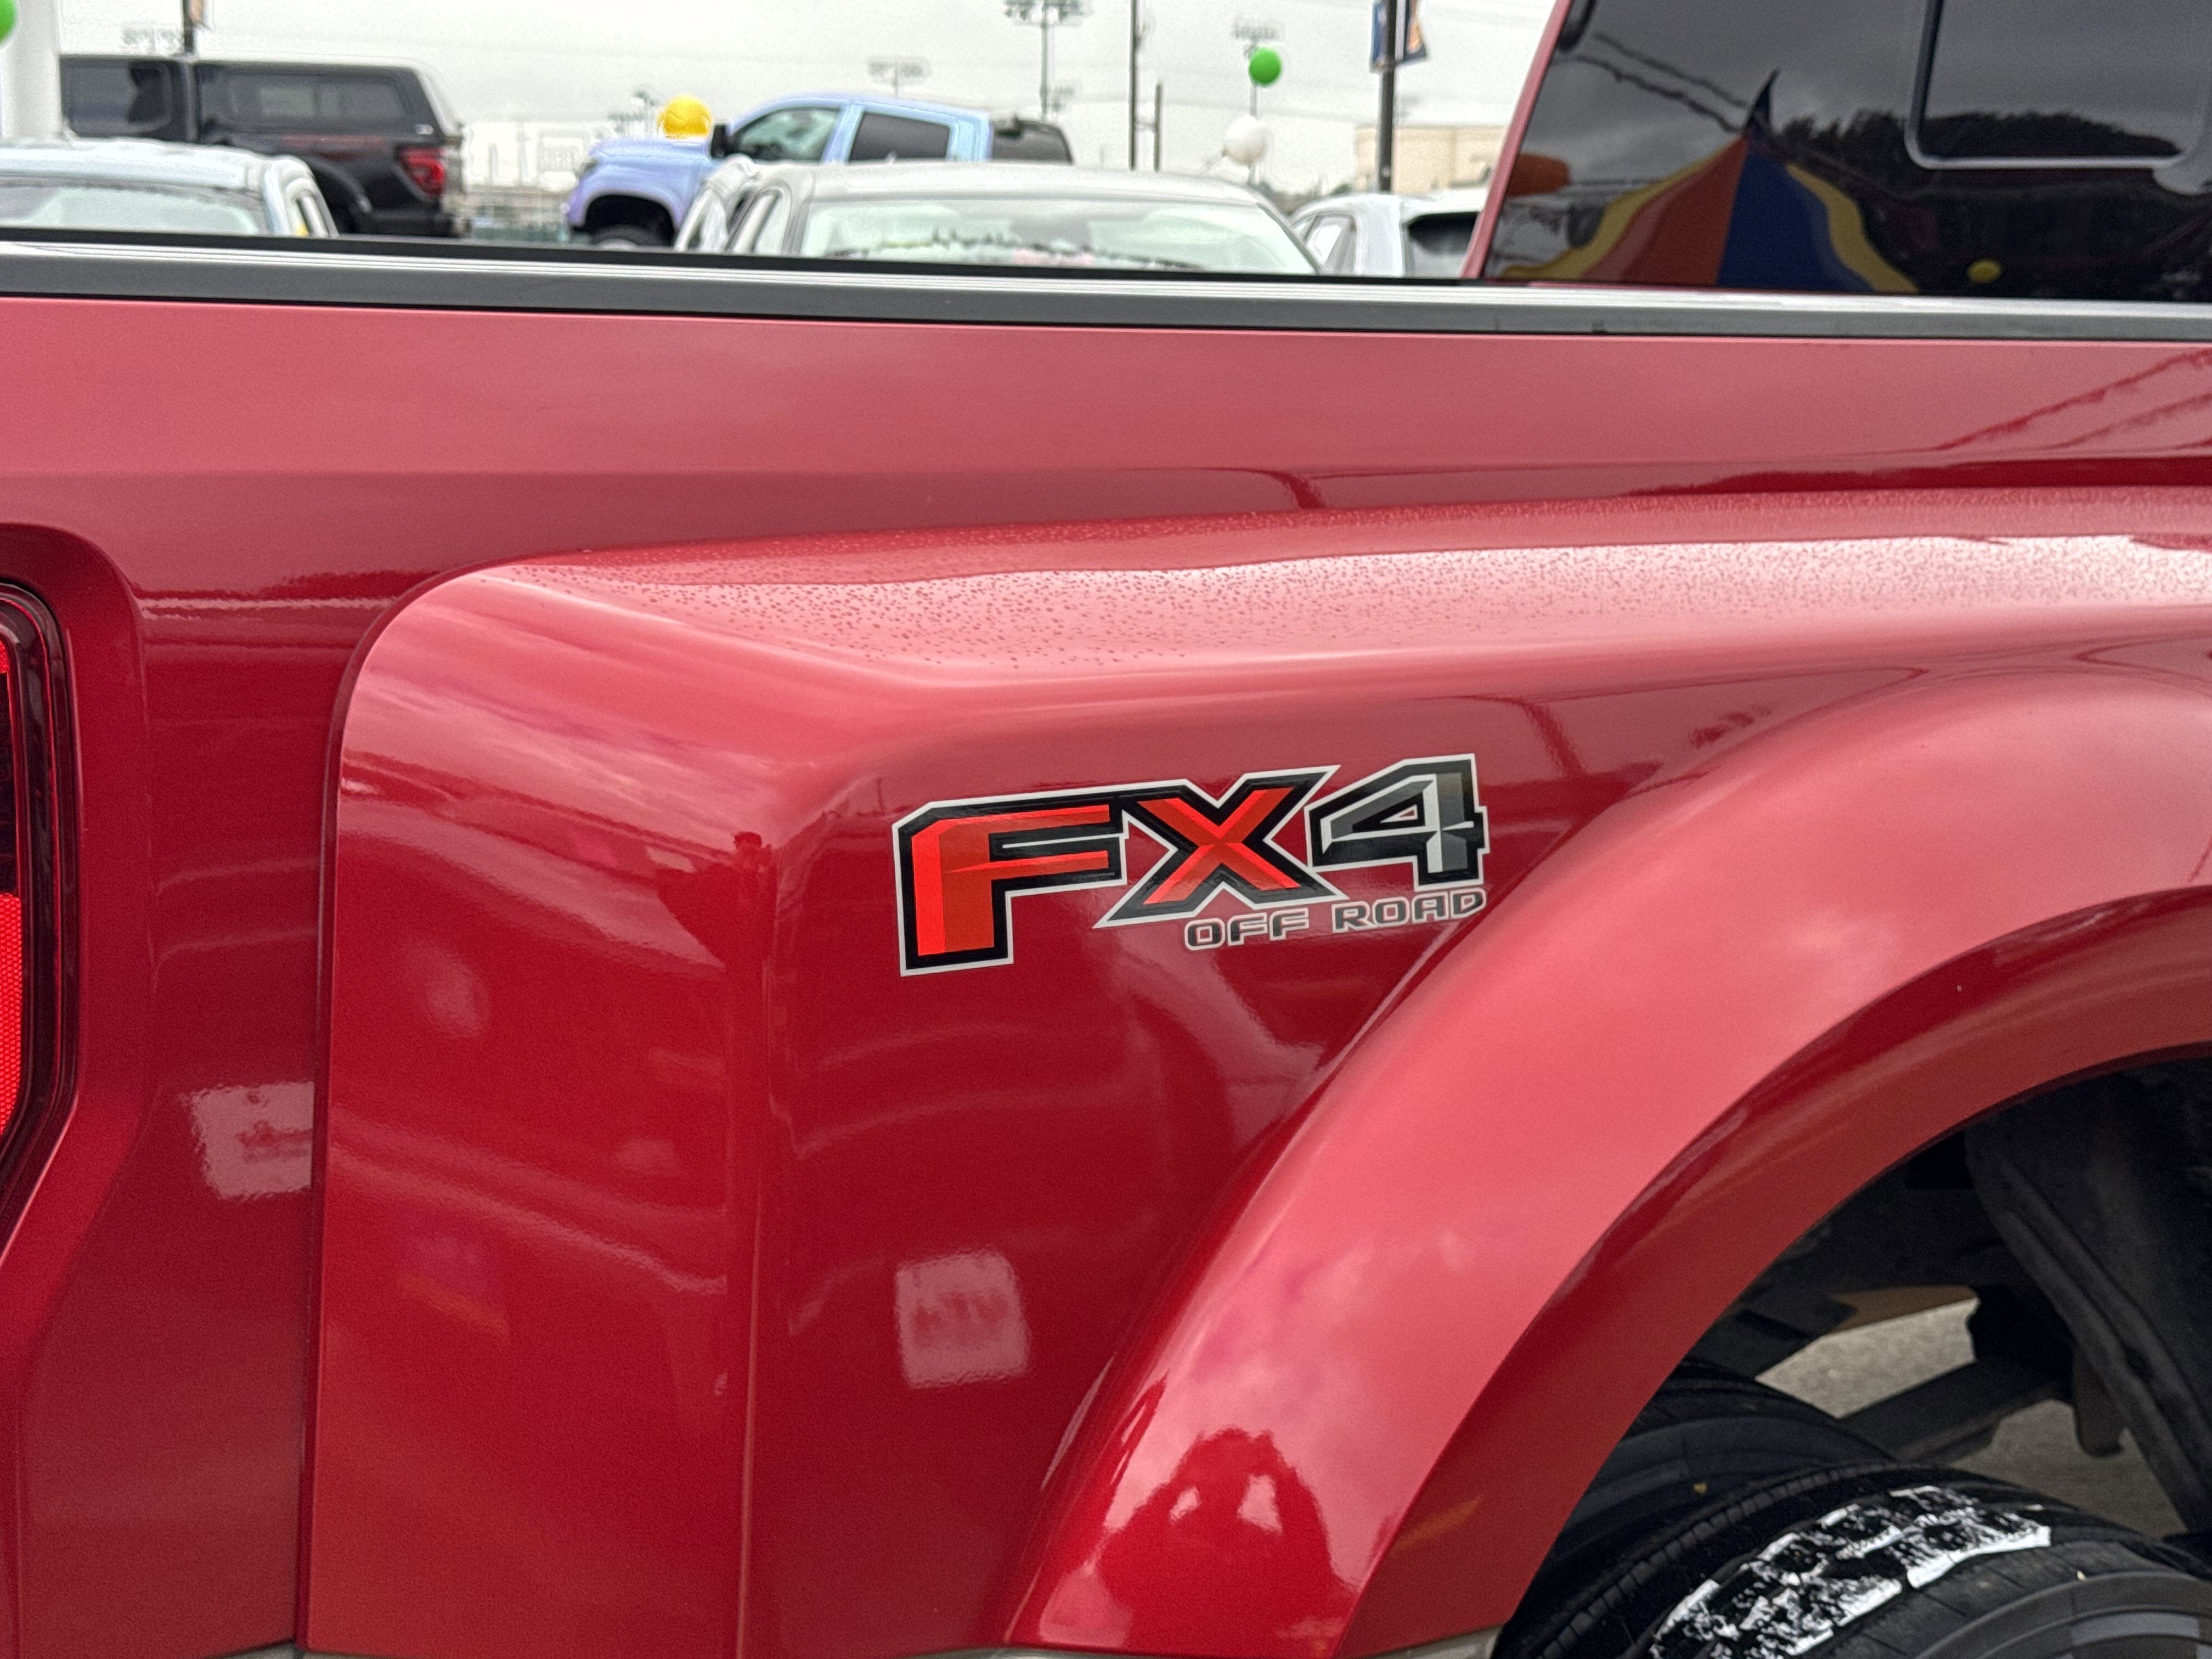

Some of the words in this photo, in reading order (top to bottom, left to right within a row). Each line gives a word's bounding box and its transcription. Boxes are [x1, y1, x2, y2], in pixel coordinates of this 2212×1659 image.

[891, 754, 1489, 976] FX4
[1184, 908, 1310, 950] OFF
[1333, 888, 1487, 933] ROAD
